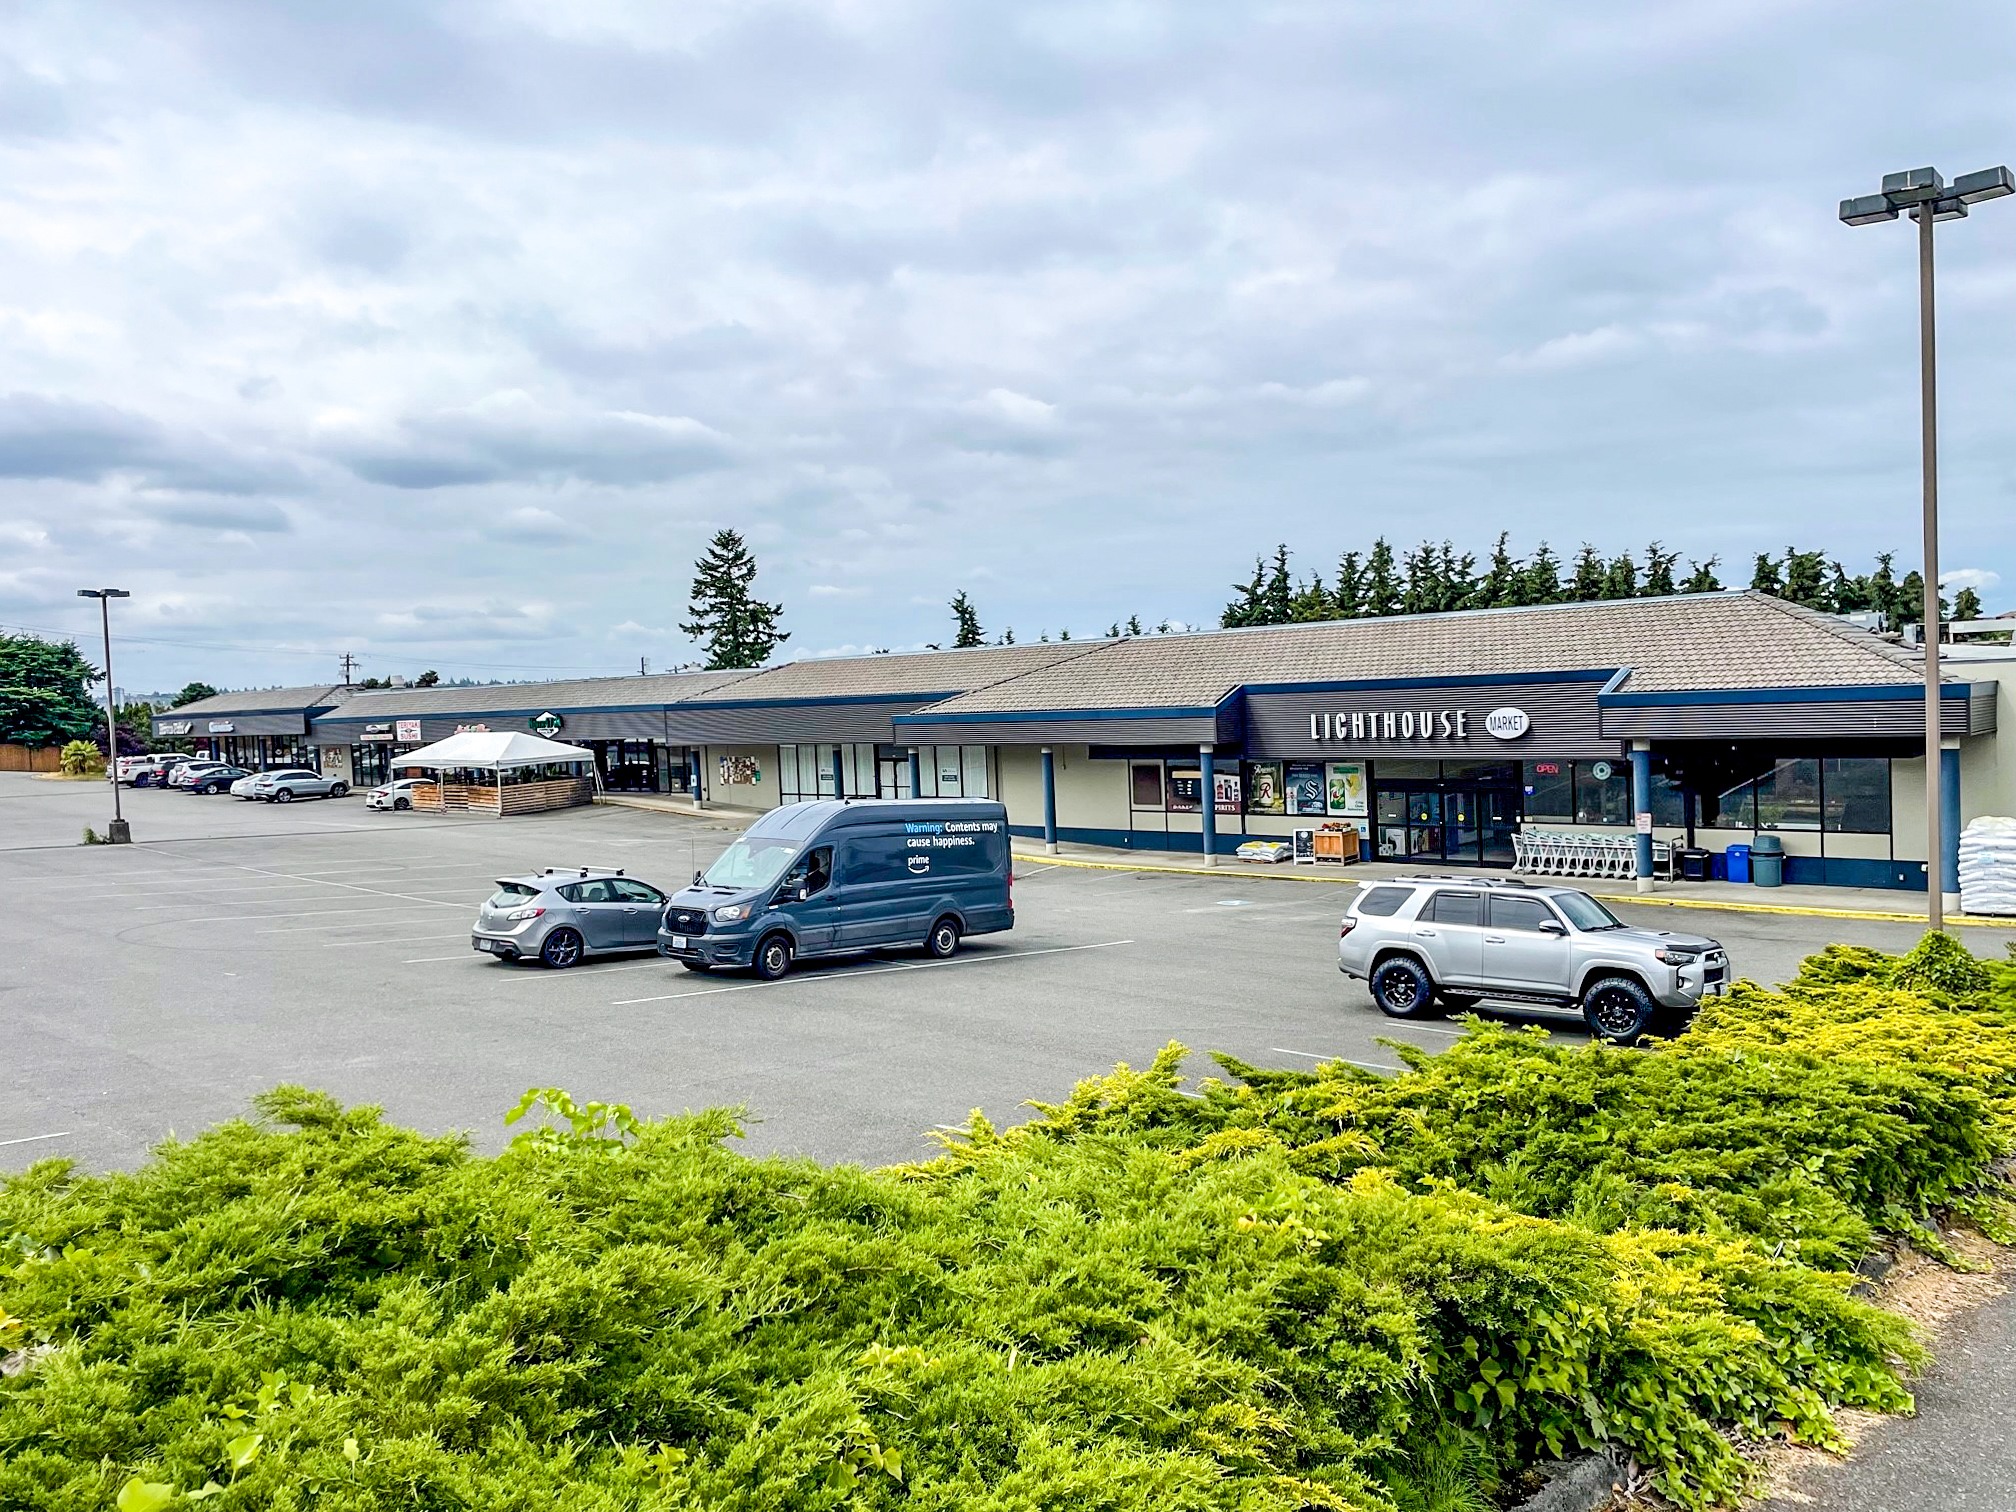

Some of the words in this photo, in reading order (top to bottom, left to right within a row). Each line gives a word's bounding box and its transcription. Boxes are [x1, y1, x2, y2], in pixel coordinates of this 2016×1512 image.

[1310, 710, 1467, 740] LIGHTHOUSE
[1489, 715, 1524, 731] MARKET
[1536, 764, 1559, 774] OPEN
[905, 822, 943, 834] Warning:
[945, 822, 981, 832] Contents
[982, 822, 998, 834] may
[907, 838, 931, 848] cause
[933, 835, 975, 848] happiness.
[908, 855, 929, 866] prime
